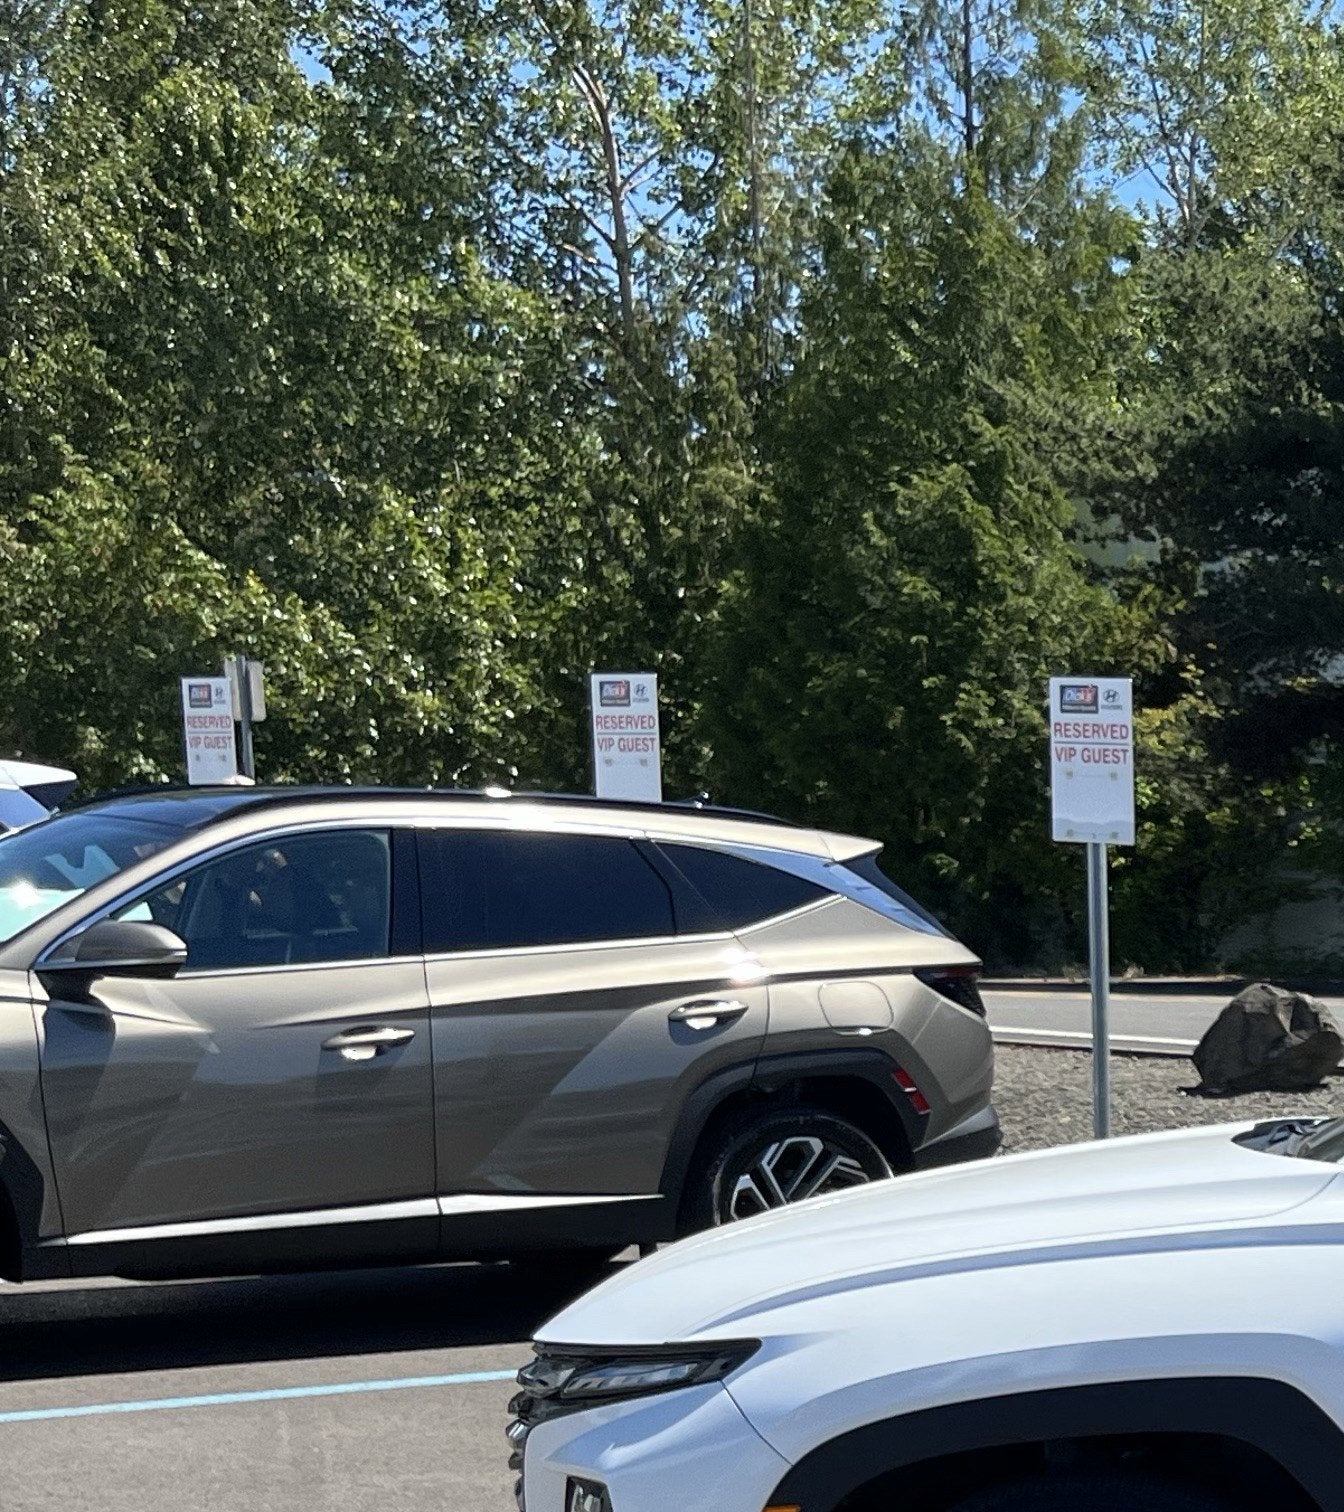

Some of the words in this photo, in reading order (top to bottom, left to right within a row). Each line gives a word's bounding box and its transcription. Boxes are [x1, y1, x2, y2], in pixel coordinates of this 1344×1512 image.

[186, 715, 232, 729] RESERVED
[595, 714, 656, 730] RESERVED
[1053, 722, 1129, 740] RESERVED
[187, 735, 202, 749] VIP
[203, 735, 233, 750] GUEST
[596, 737, 615, 753] VIP
[617, 737, 657, 753] GUEST
[1054, 746, 1077, 763] VIP
[1081, 747, 1129, 765] GUEST
